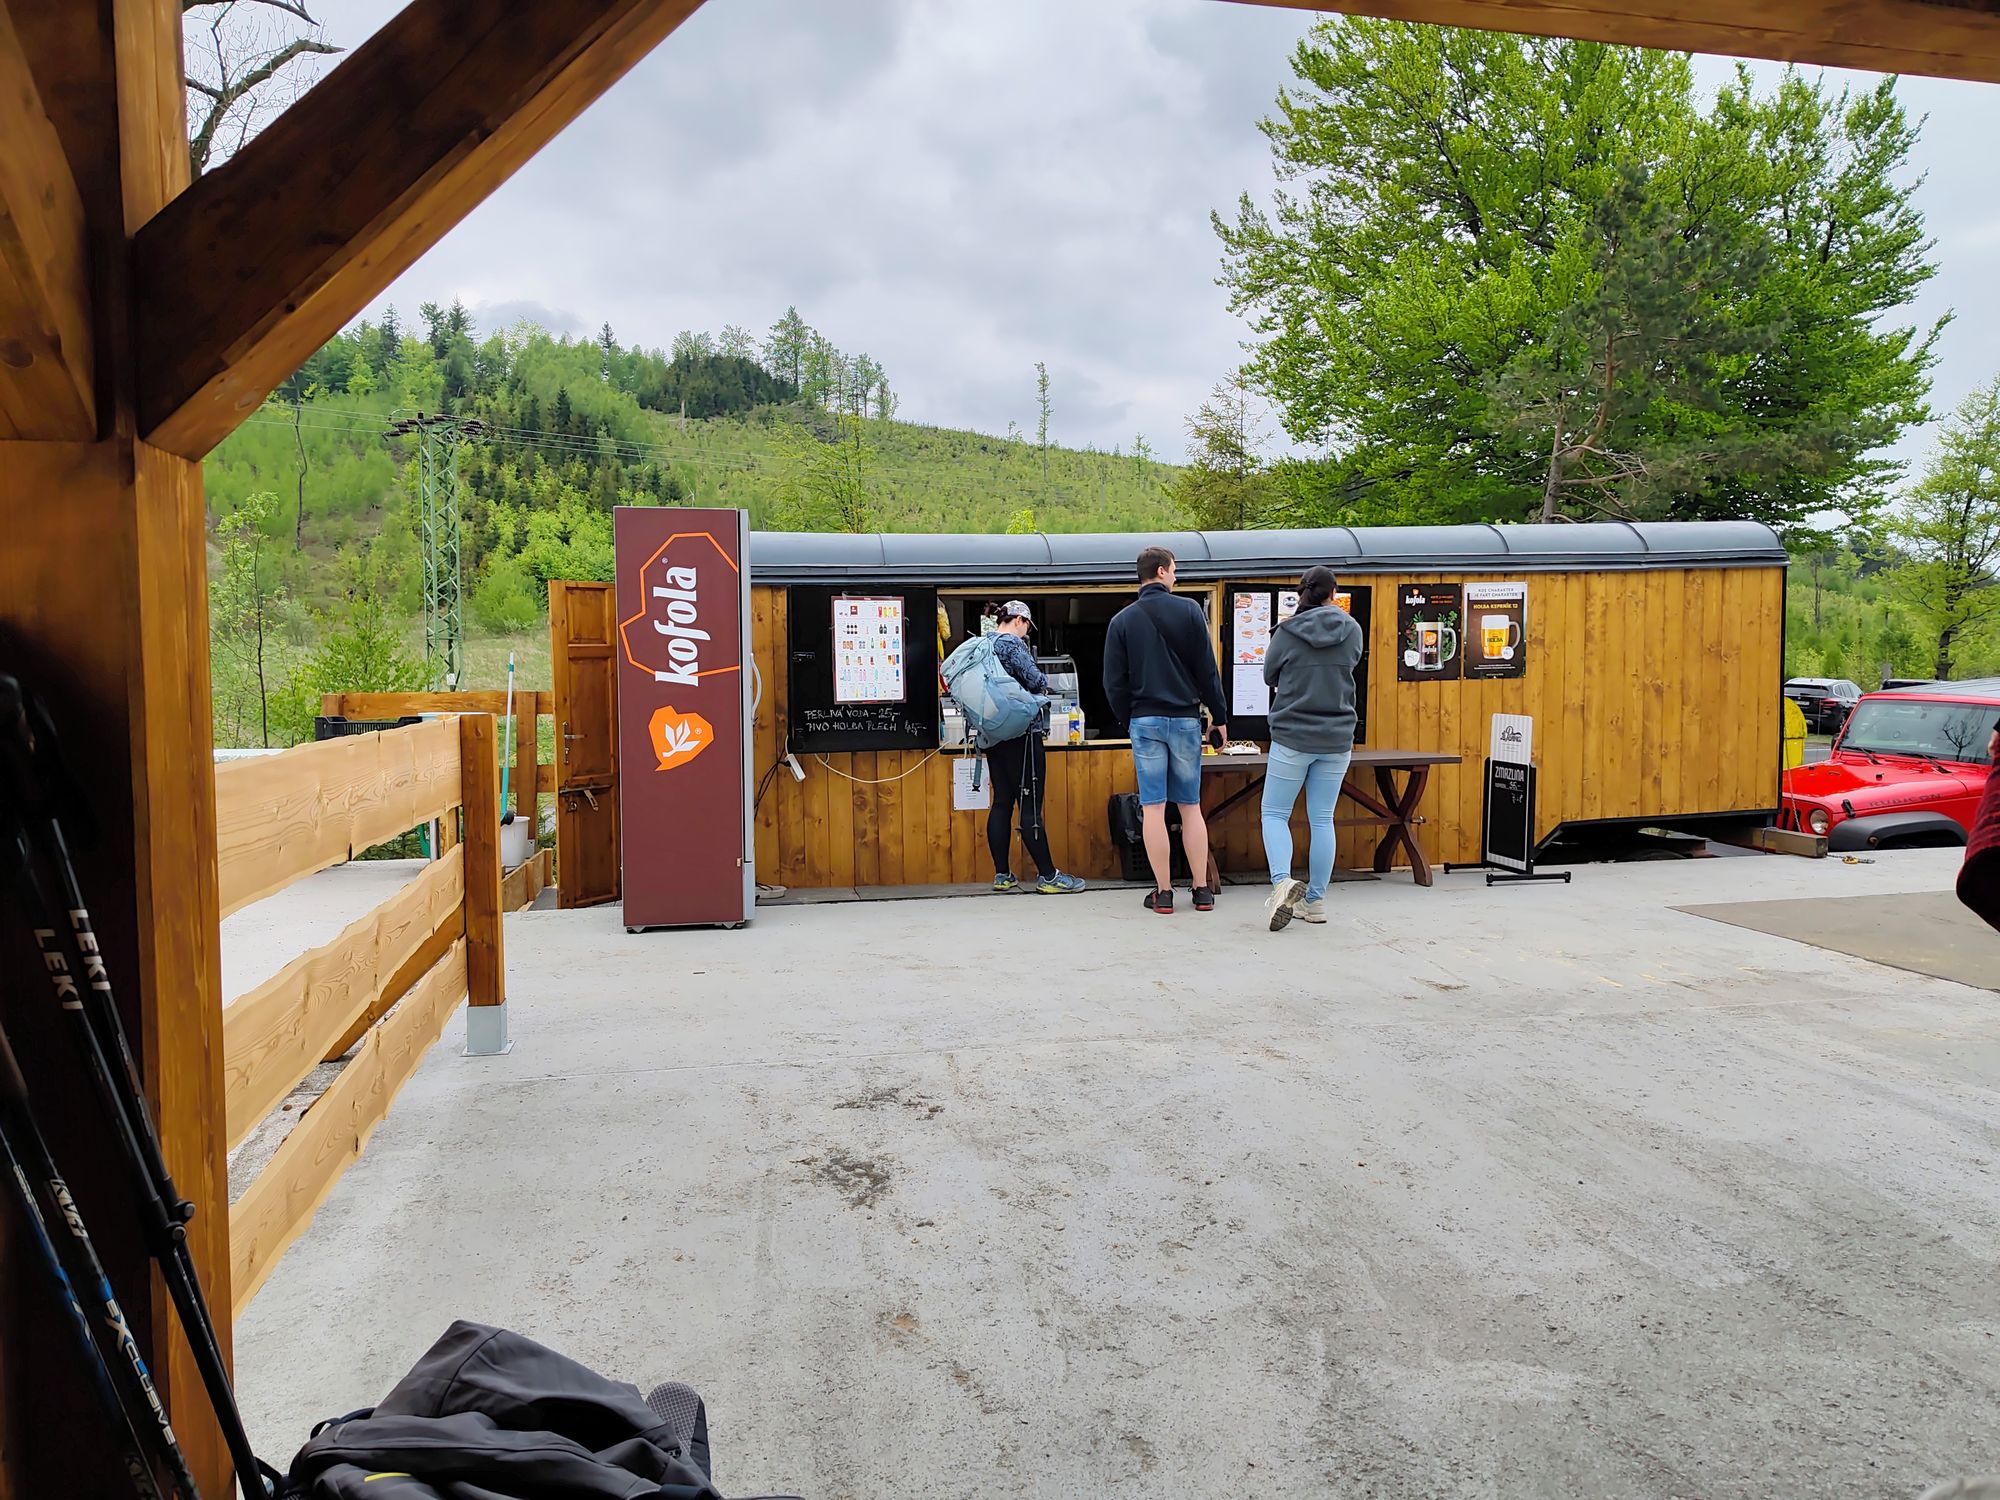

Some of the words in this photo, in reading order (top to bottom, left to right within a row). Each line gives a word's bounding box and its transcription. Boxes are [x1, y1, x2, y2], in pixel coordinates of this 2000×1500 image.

[652, 566, 711, 687] kofola
[1405, 594, 1426, 607] kofola
[1494, 766, 1525, 782] ZMRZLINA
[33, 928, 83, 1010] LEKI
[68, 908, 111, 991] LEKI
[105, 1298, 176, 1446] EXCLUSIVE
